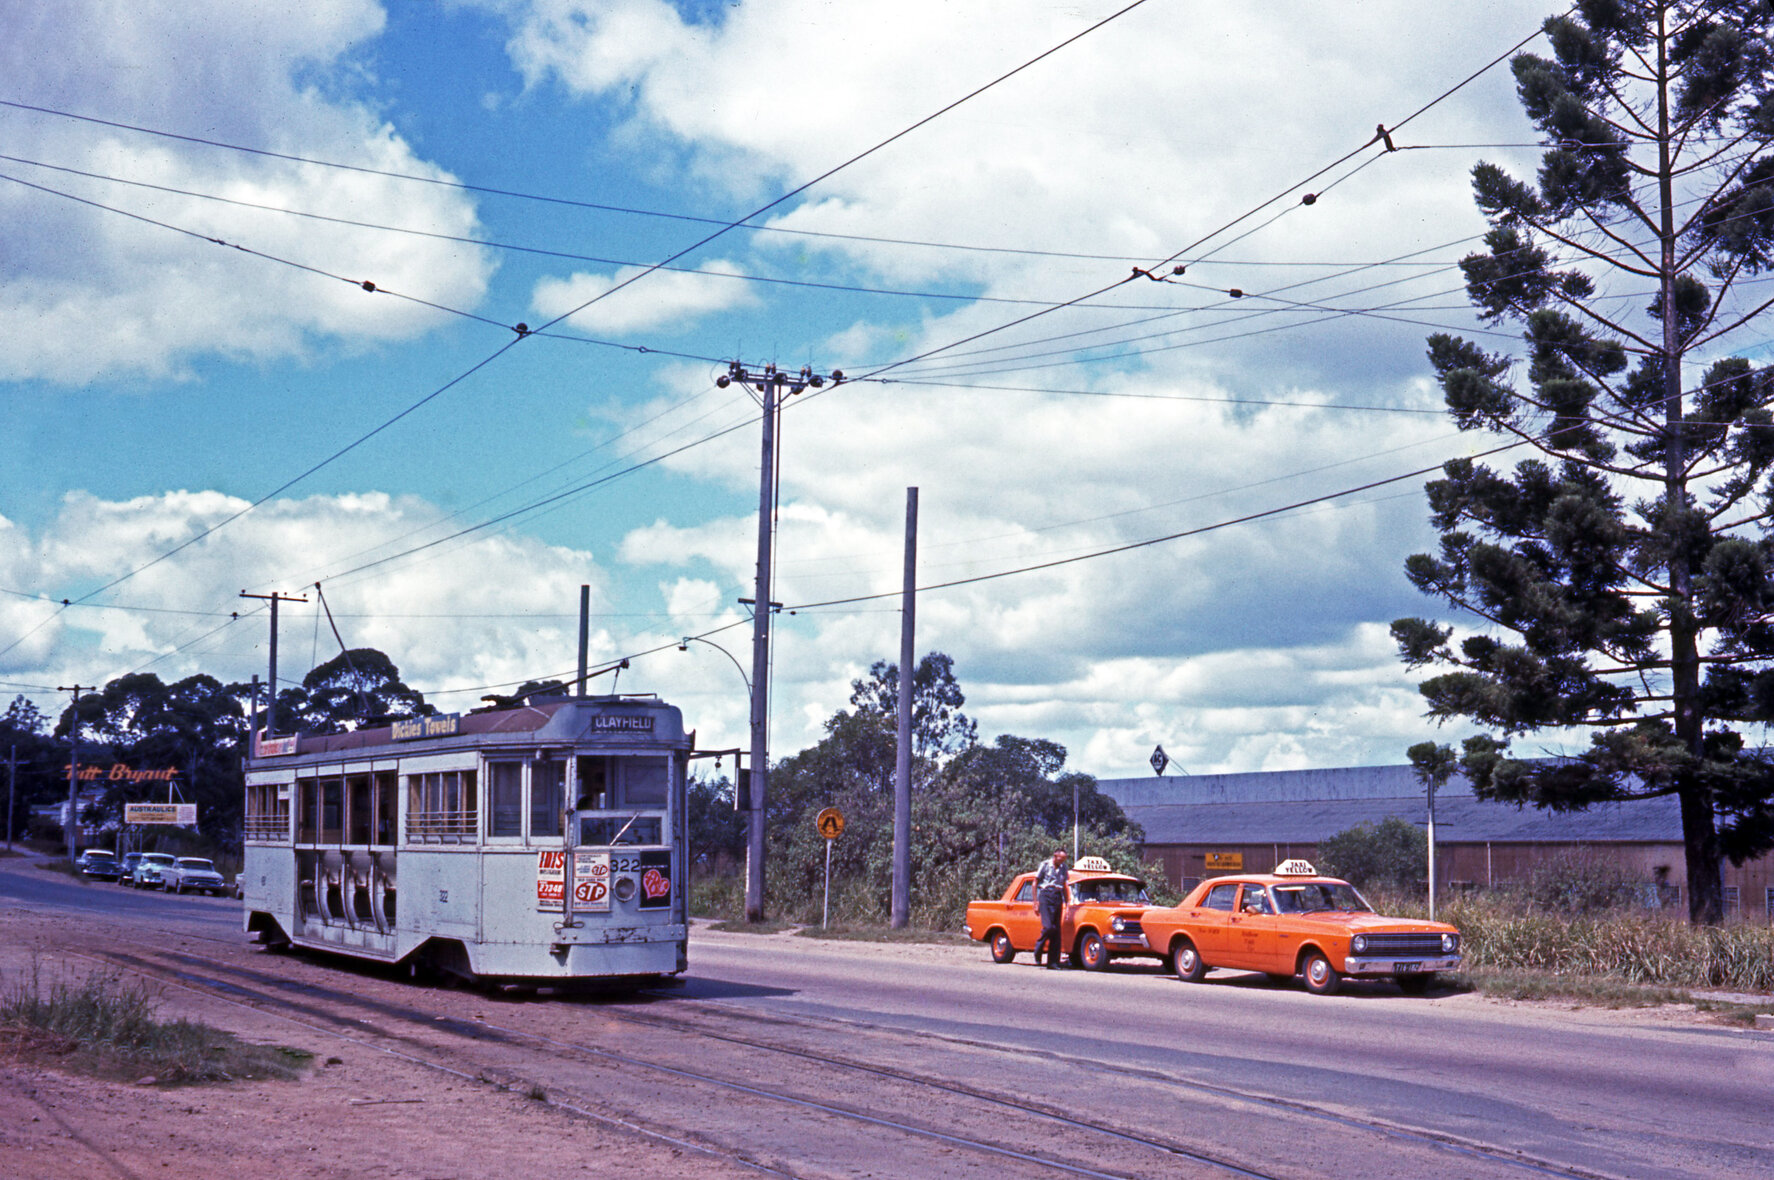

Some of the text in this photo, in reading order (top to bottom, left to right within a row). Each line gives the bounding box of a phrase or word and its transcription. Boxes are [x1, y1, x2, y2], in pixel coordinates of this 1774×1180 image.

[392, 715, 456, 740] Dickies Towels
[595, 716, 651, 729] CLAYFIELD
[109, 763, 179, 783] Bryant
[592, 865, 607, 875] STP
[610, 859, 640, 872] 322
[578, 883, 604, 900] STP
